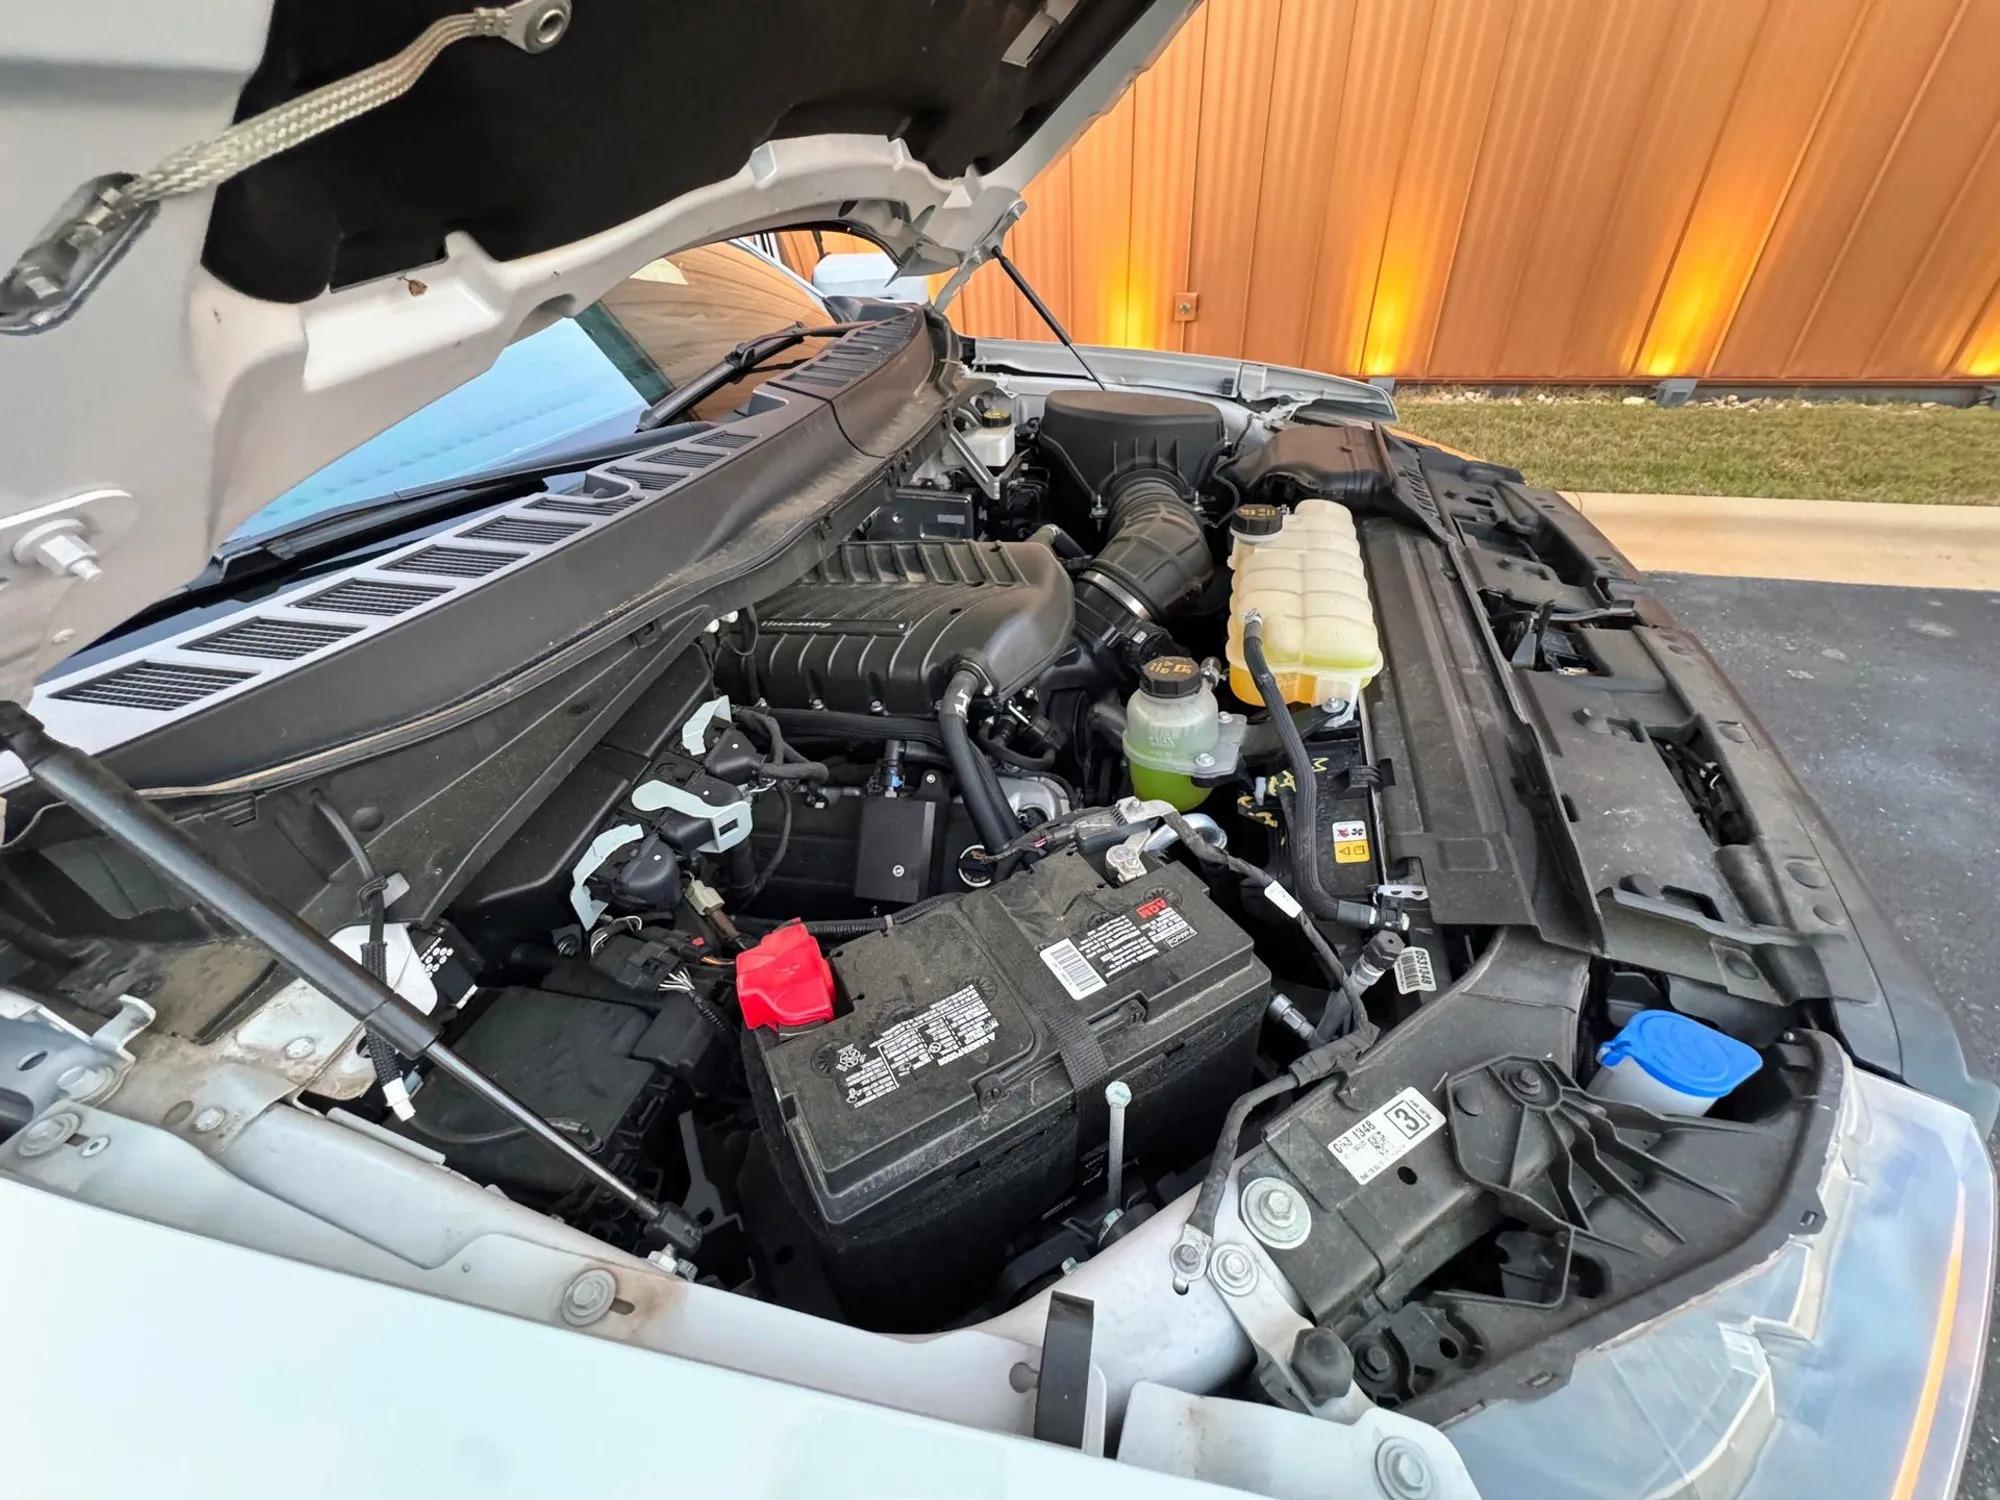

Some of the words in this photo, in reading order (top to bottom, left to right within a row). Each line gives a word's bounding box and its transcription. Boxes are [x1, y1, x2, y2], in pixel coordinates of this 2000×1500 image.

[1136, 898, 1167, 919] AGM
[1352, 1119, 1376, 1140] 1348
[1394, 1107, 1420, 1132] 3
